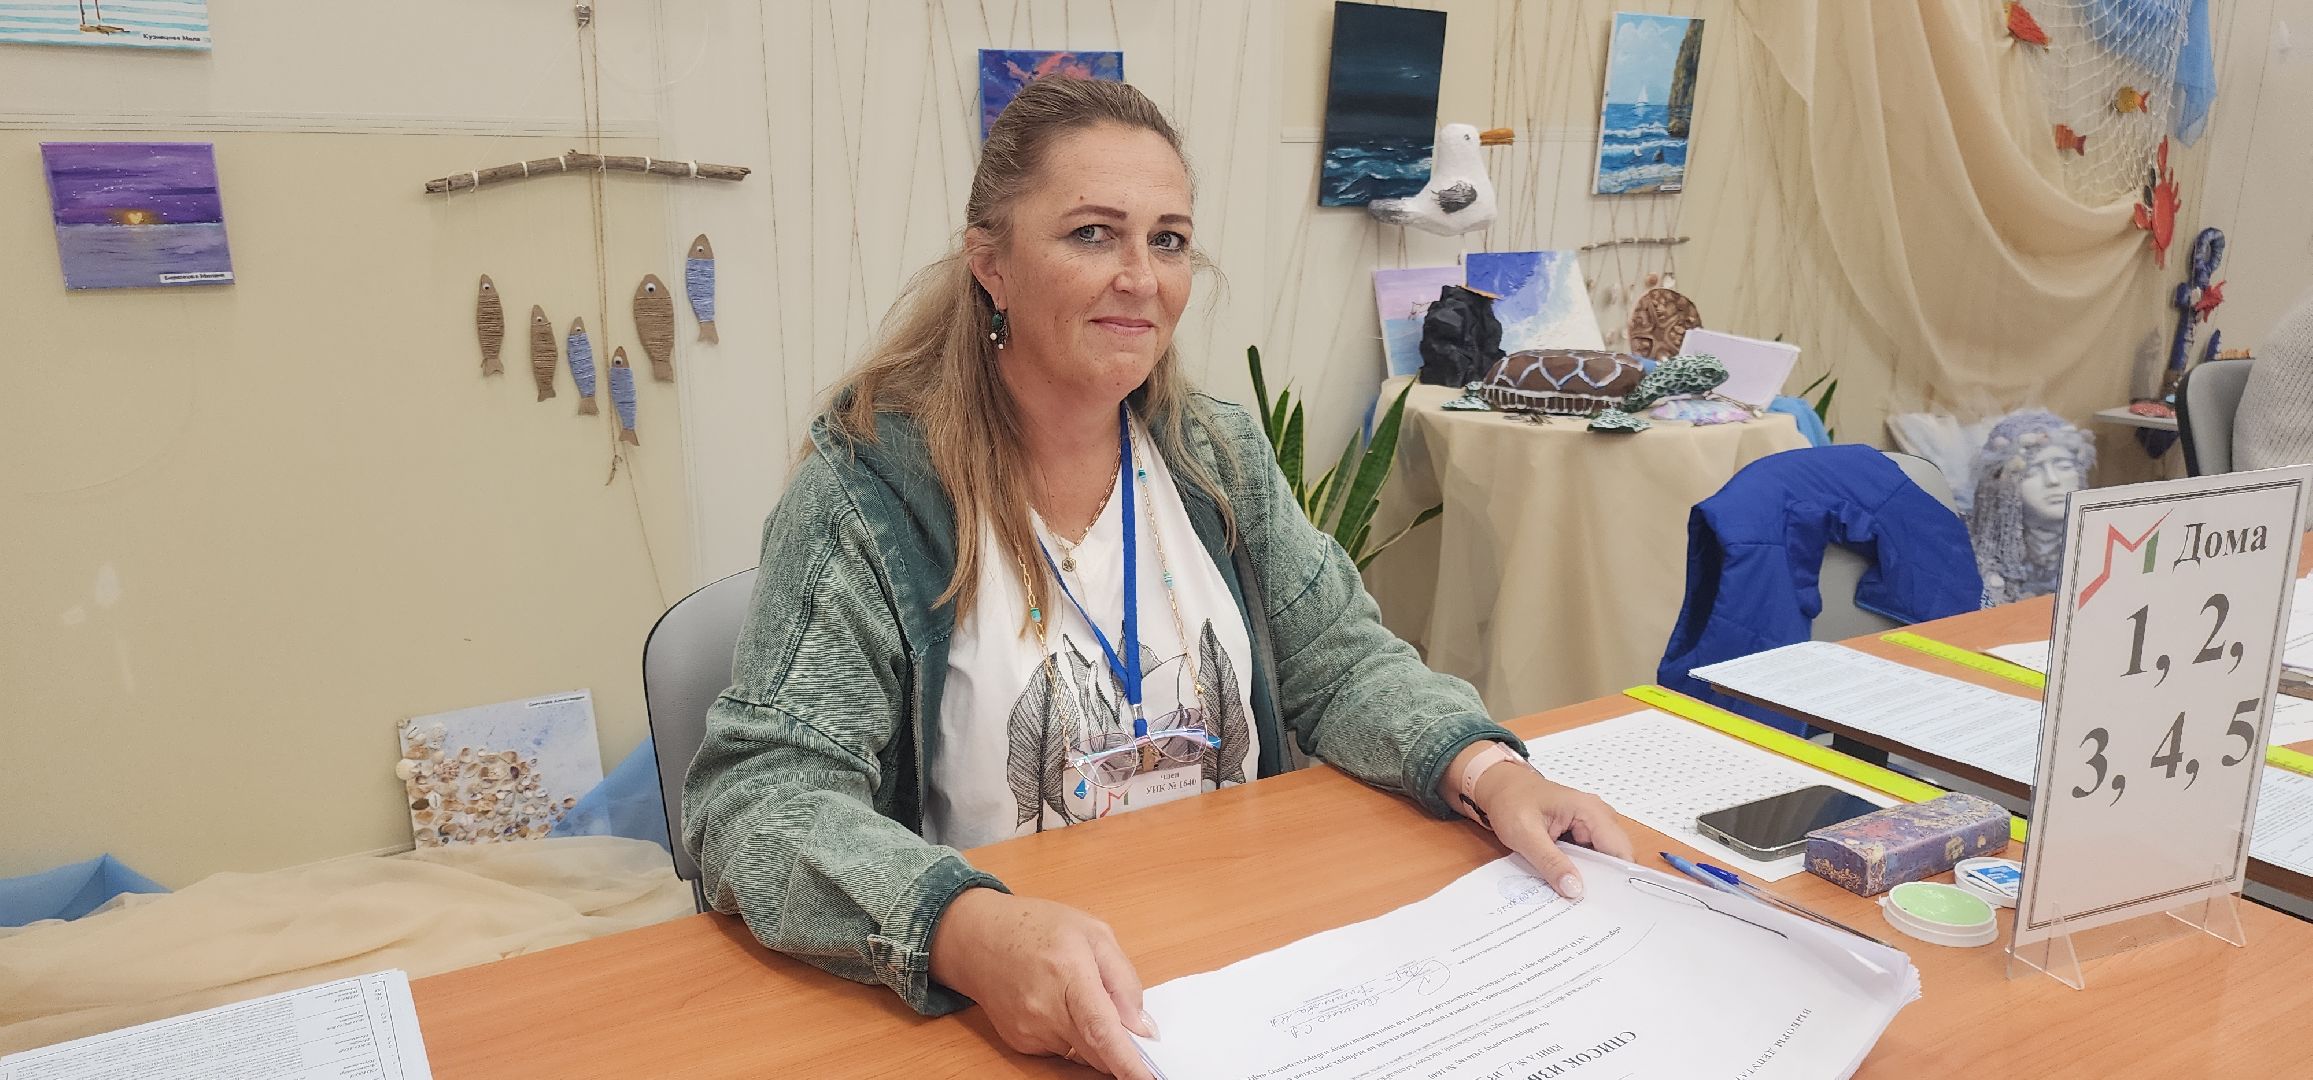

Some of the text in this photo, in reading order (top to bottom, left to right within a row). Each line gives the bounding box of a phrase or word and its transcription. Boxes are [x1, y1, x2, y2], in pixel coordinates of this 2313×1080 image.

[2172, 523, 2267, 575] Дома
[2120, 593, 2244, 688] 1, 2,
[2072, 697, 2260, 807] 3, 4, 5
[1522, 1027, 1637, 1080] СПИСОК ИЗБ
